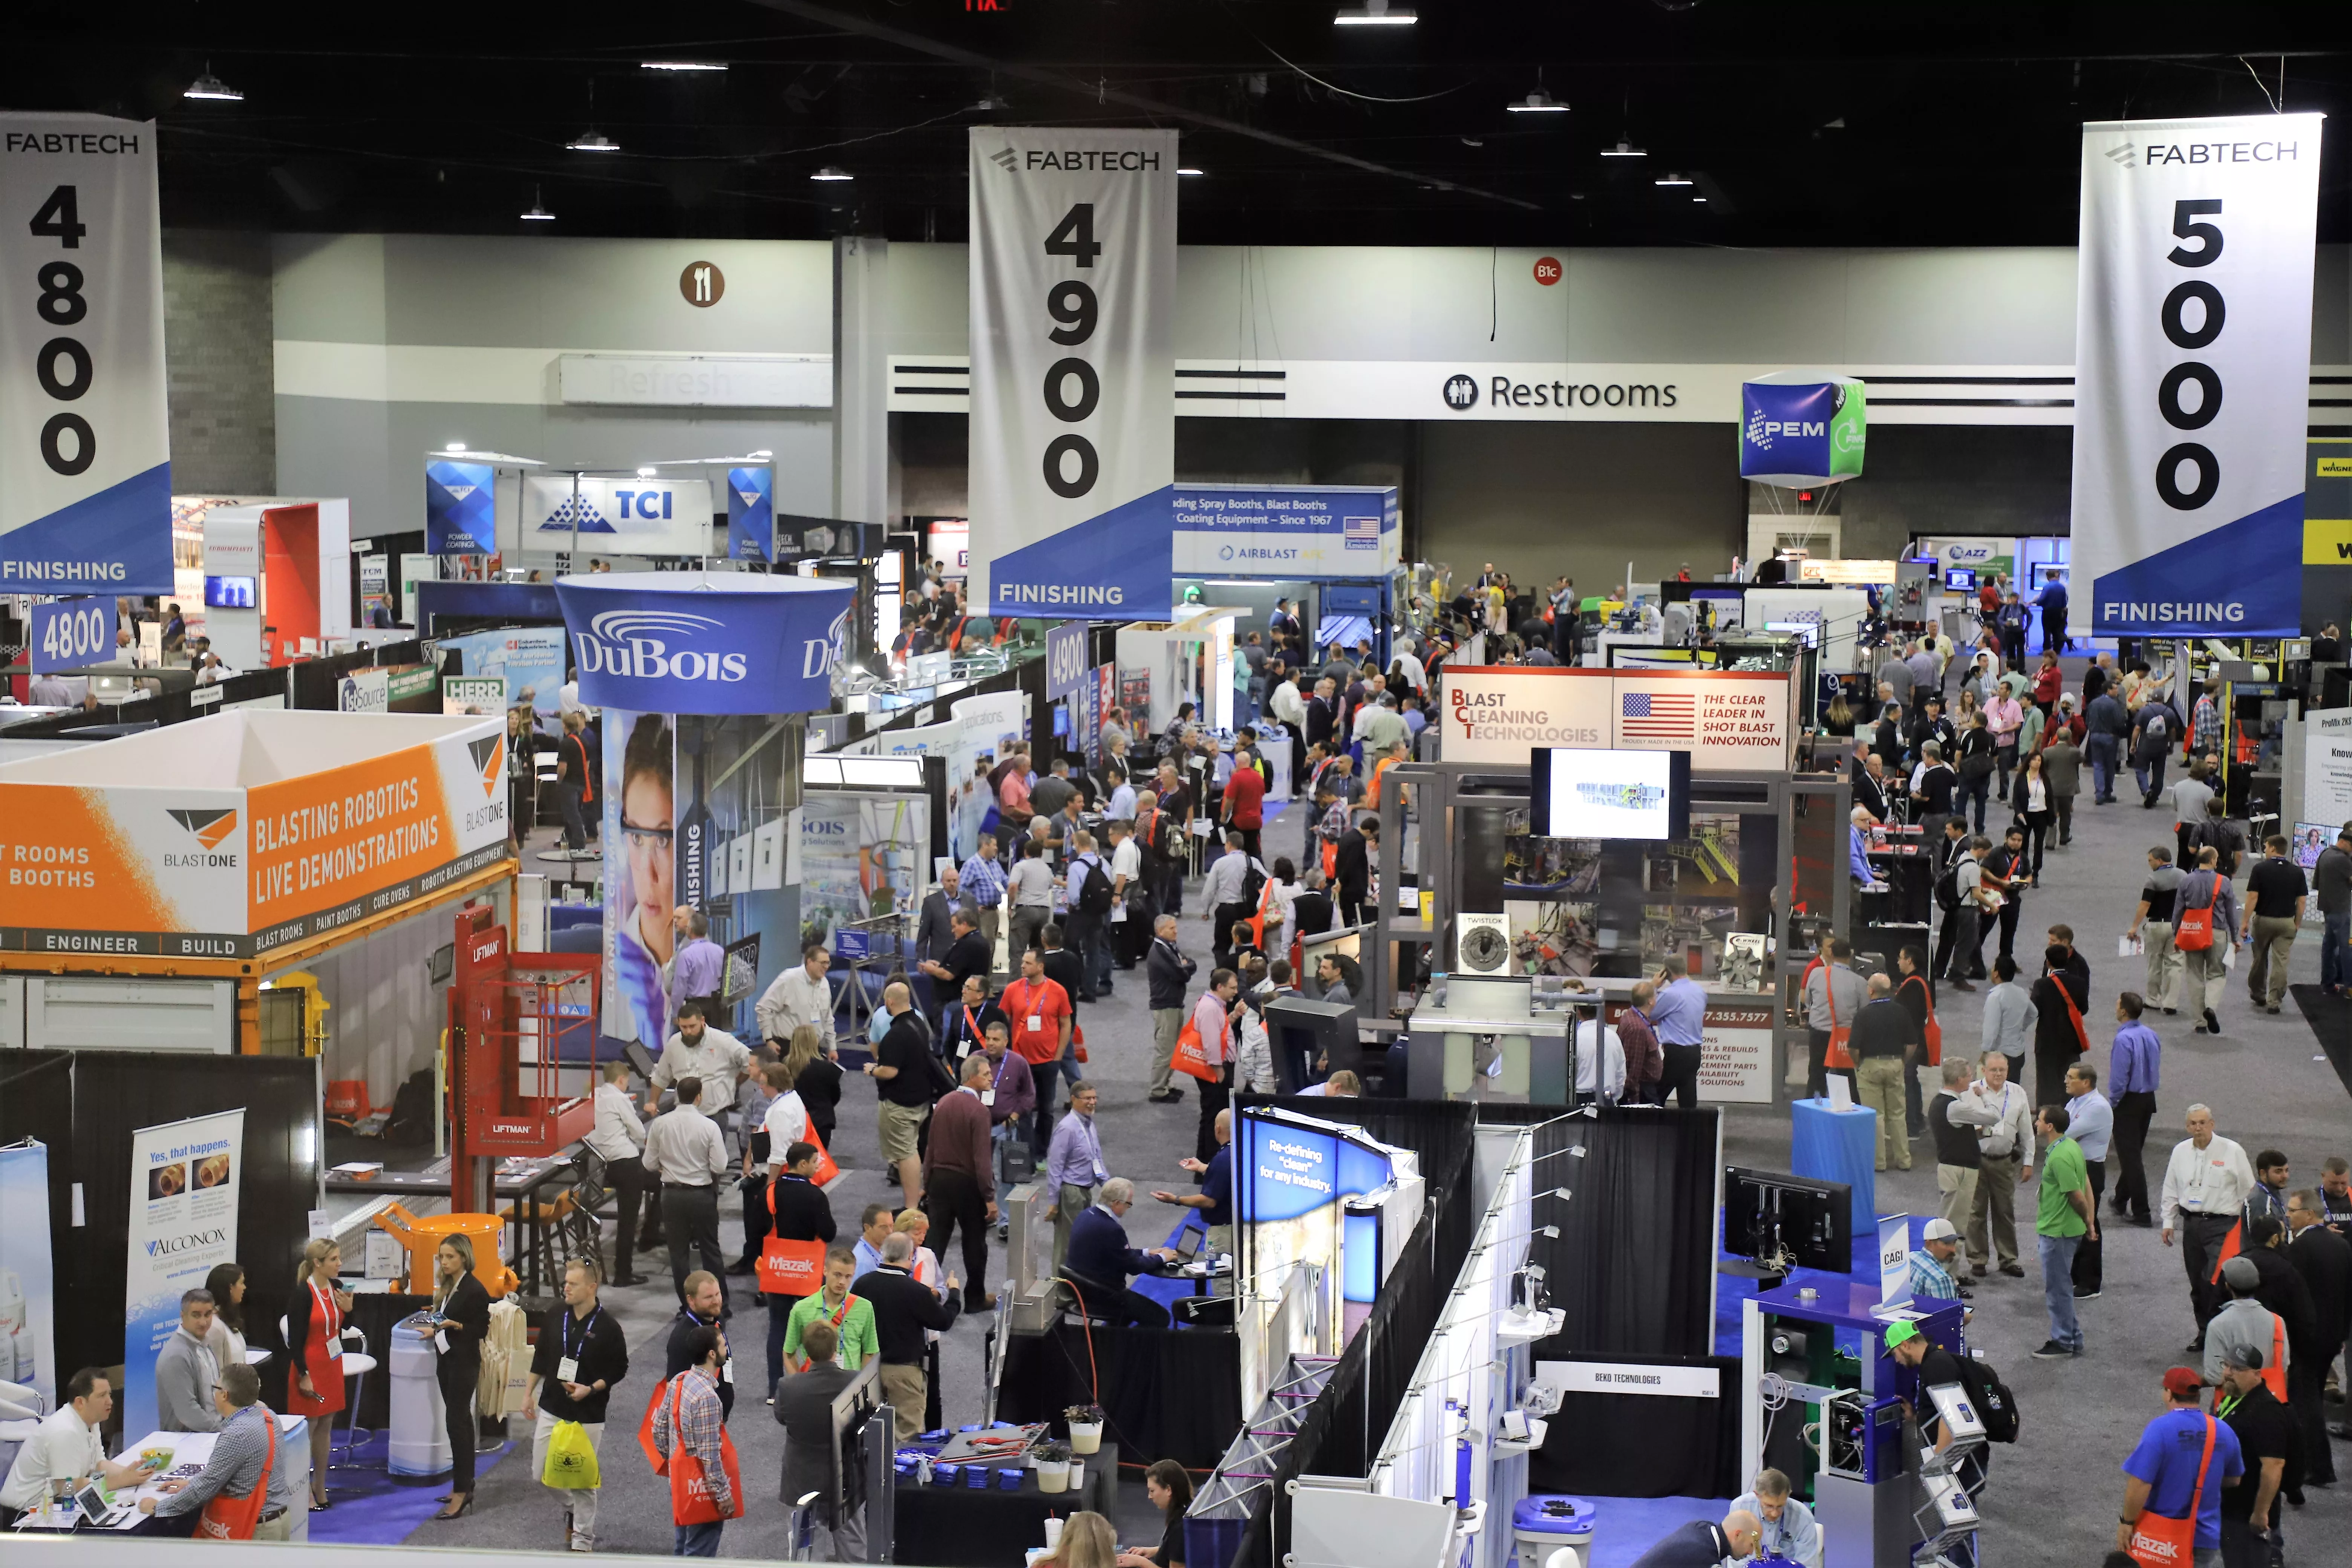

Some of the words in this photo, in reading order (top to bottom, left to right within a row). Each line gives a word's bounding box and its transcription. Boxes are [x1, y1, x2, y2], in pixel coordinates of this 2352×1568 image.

[6, 133, 139, 154] FABTECH
[2147, 141, 2298, 165] FABTECH
[1027, 151, 1160, 171] FABTECH
[1537, 265, 1557, 278] B1c
[1491, 377, 1677, 407] Restrooms
[1765, 421, 1825, 437] PEM
[616, 491, 672, 519] TCI
[1199, 499, 1226, 511] Spray
[1228, 499, 1265, 510] Booths,
[1266, 500, 1290, 510] Blast
[1292, 500, 1327, 510] Booths
[1176, 513, 1214, 526] Coating
[1216, 514, 1268, 527] Equipment
[1279, 515, 1306, 525] Since
[1309, 515, 1332, 525] 1967
[1239, 548, 1298, 559] AIRBLAST
[1964, 549, 1988, 558] AZZ
[3, 560, 126, 581] FINISHING
[1000, 584, 1123, 605] FINISHING
[2104, 602, 2245, 622] FINISHING
[43, 606, 105, 661] 4800
[1054, 632, 1084, 685] 4900
[450, 681, 501, 698] HERR
[1452, 689, 1506, 707] BLAST
[1703, 694, 1725, 704] THE
[1729, 695, 1765, 705] CLEAR
[1455, 706, 1548, 724] CLEANING
[1703, 708, 1747, 718] LEADER
[1750, 709, 1765, 718] IN
[2322, 718, 2340, 728] ProMix
[2342, 717, 2352, 726] 2KS
[1462, 724, 1598, 744] TECHNOLOGIES
[1703, 722, 1736, 732] SHOT
[1739, 723, 1775, 733] BLAST
[1702, 737, 1781, 747] INNOVATION
[2321, 763, 2346, 771] Empowering
[256, 801, 338, 855] BLASTING
[344, 776, 418, 830] ROBOTICS
[467, 802, 503, 832] BLASTONE
[608, 793, 616, 898] CHEMISTRY
[808, 838, 845, 846] Solutions
[15, 845, 89, 864] ROOMS
[164, 854, 237, 867] BLASTONE
[256, 861, 292, 904] LIVE
[300, 815, 438, 891] DEMONSTRATIONS
[9, 868, 95, 888] BOOTHS
[421, 871, 445, 892] ROBOTIC
[446, 858, 473, 880] BLASTING
[473, 844, 504, 870] EQUIPMENT
[373, 894, 389, 910] CURE
[390, 885, 410, 905] OVENS
[316, 914, 335, 932] PAINT
[336, 903, 361, 925] BOOTHS
[46, 934, 138, 952] ENGINEER
[256, 929, 278, 951] BLAST
[280, 922, 303, 943] ROOMS
[182, 939, 236, 955] BUILD
[473, 940, 499, 963] LIFTMAN
[608, 902, 616, 1003] CLEANING
[493, 1124, 530, 1134] LIFTMAN
[151, 1152, 168, 1163] Yes,
[171, 1146, 187, 1159] that
[190, 1139, 231, 1156] happens.
[1269, 1139, 1323, 1164] Re-defining
[1260, 1165, 1274, 1178] for
[1275, 1170, 1292, 1186] any
[1292, 1172, 1332, 1194] industry.
[155, 1227, 225, 1257] ALCONOX
[152, 1262, 173, 1272] Critical
[175, 1254, 200, 1266] Cleaning
[769, 1256, 815, 1273] Mazak
[1885, 1250, 1903, 1265] CAGI
[1595, 1372, 1612, 1383] BEKO
[1614, 1373, 1661, 1385] TECHNOLOGIES
